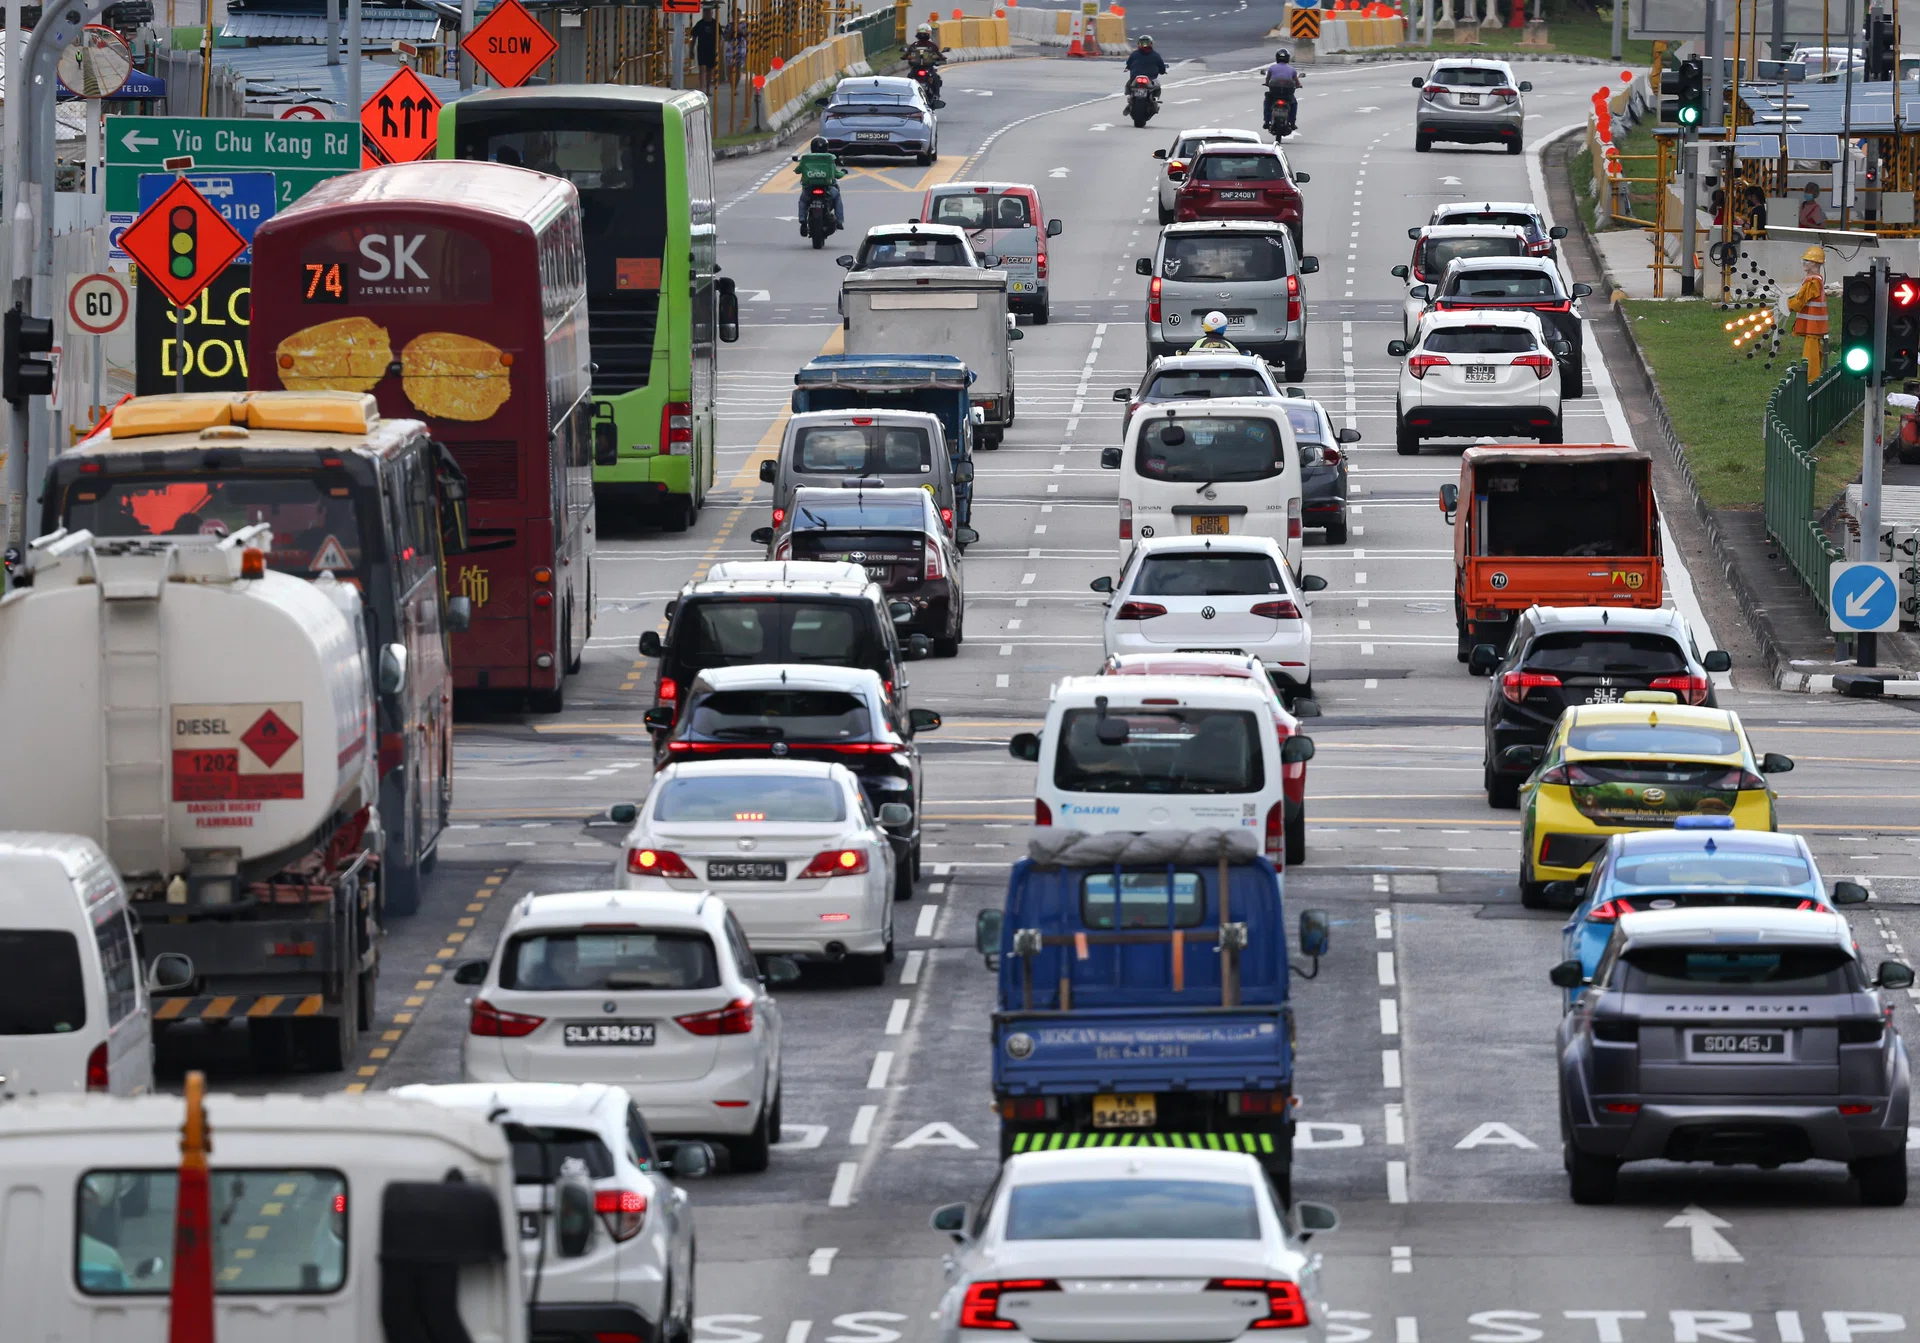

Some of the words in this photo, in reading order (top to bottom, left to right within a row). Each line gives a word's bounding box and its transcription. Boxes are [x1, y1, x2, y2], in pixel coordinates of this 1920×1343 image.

[392, 10, 407, 18] AVE
[488, 36, 532, 54] SLOW
[133, 85, 152, 93] LTD.
[172, 129, 203, 152] Yio
[215, 130, 252, 153] Chu
[265, 131, 312, 160] Kang
[324, 132, 348, 155] Rd
[807, 170, 827, 178] Grab
[282, 180, 292, 202] 2
[208, 199, 260, 220] ane
[358, 233, 430, 281] SK
[305, 263, 343, 299] 74
[359, 286, 430, 295] JEWELLERY
[86, 292, 112, 316] 60
[166, 287, 251, 326] SLO
[1169, 315, 1180, 323] 70
[1200, 516, 1220, 525] GBB
[1142, 527, 1152, 535] 70
[1493, 575, 1506, 584] 70
[1628, 573, 1639, 582] 11
[1593, 688, 1618, 698] SLF
[176, 718, 231, 736] DIESEL
[194, 754, 238, 773] 1202
[1073, 805, 1120, 815] DAIKIN
[1704, 1036, 1772, 1051] SDQ45J
